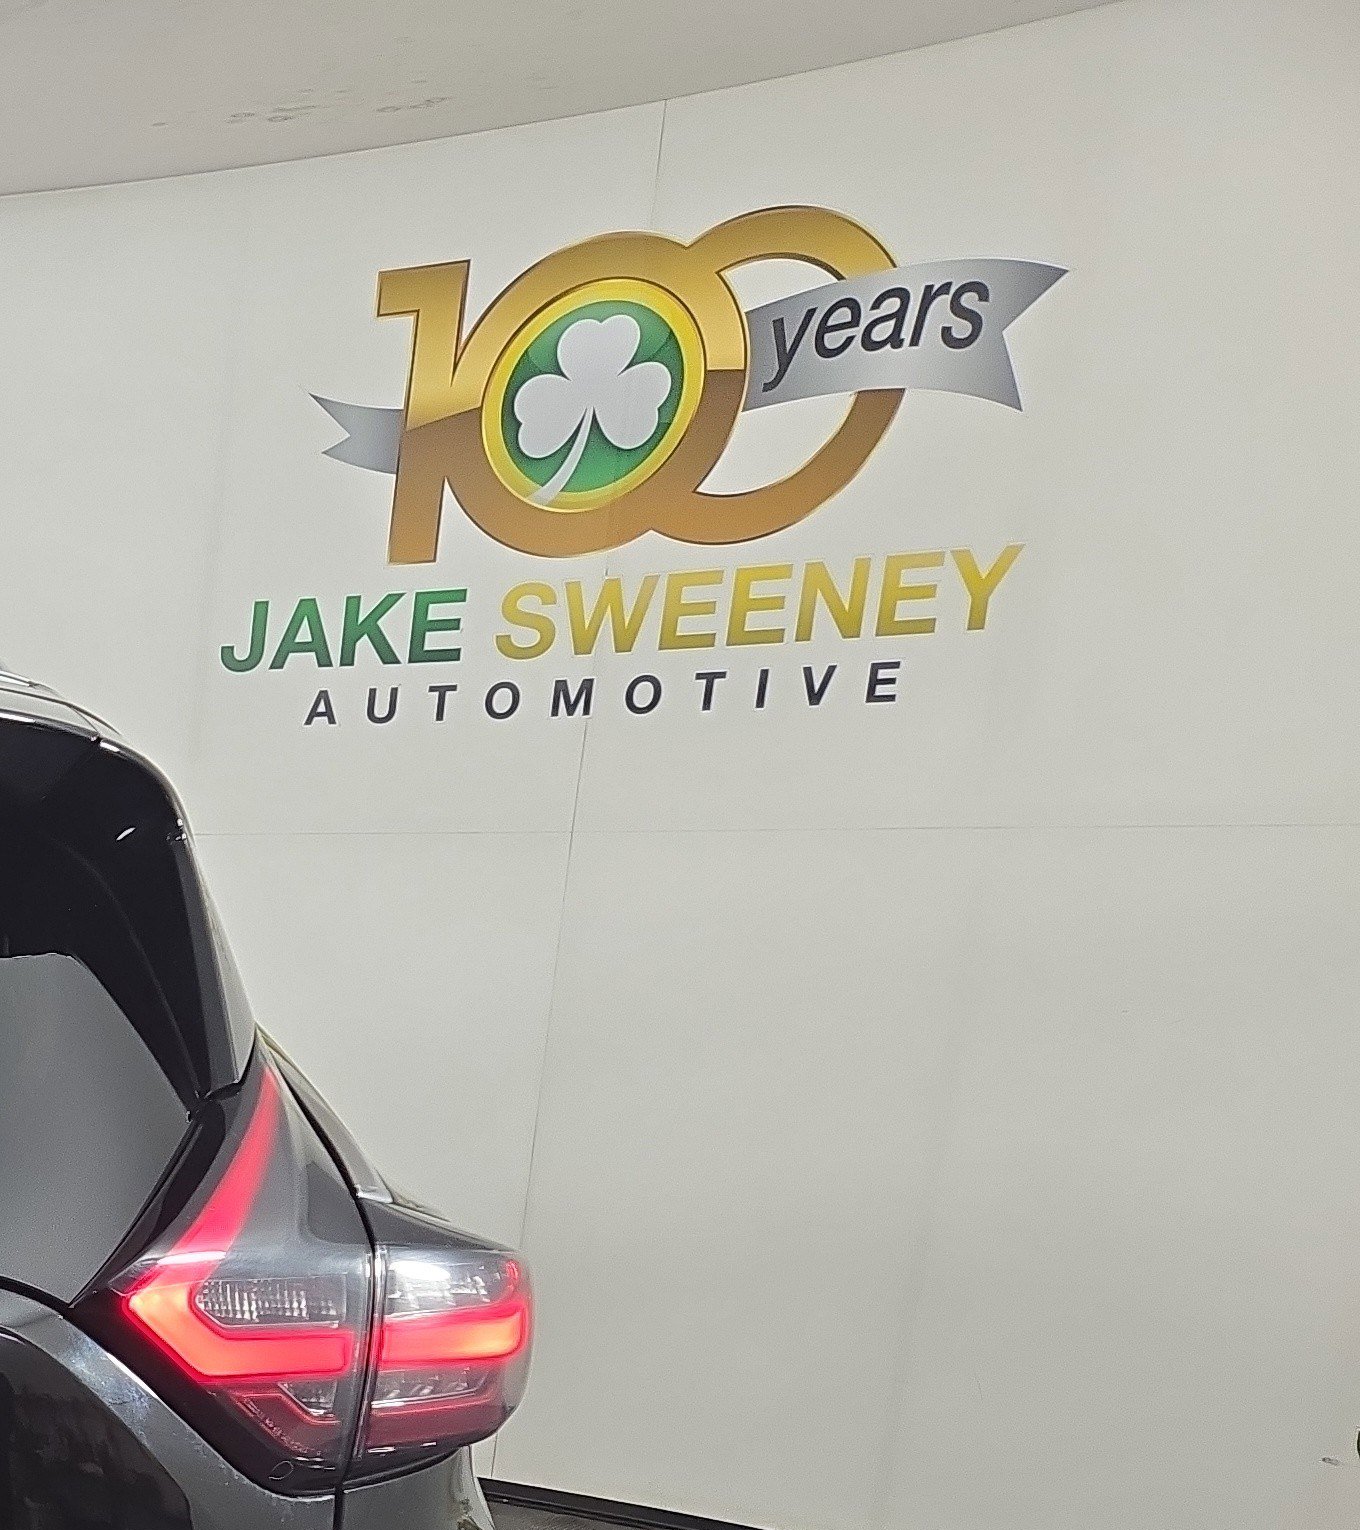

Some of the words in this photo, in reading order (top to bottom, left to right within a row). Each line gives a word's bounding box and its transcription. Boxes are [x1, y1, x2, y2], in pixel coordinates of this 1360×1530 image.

[376, 205, 906, 565] 100
[761, 280, 991, 392] years
[221, 588, 468, 673] JAKE
[495, 543, 1025, 660] SWEENEY
[304, 660, 901, 726] AUTOMOTIVE
